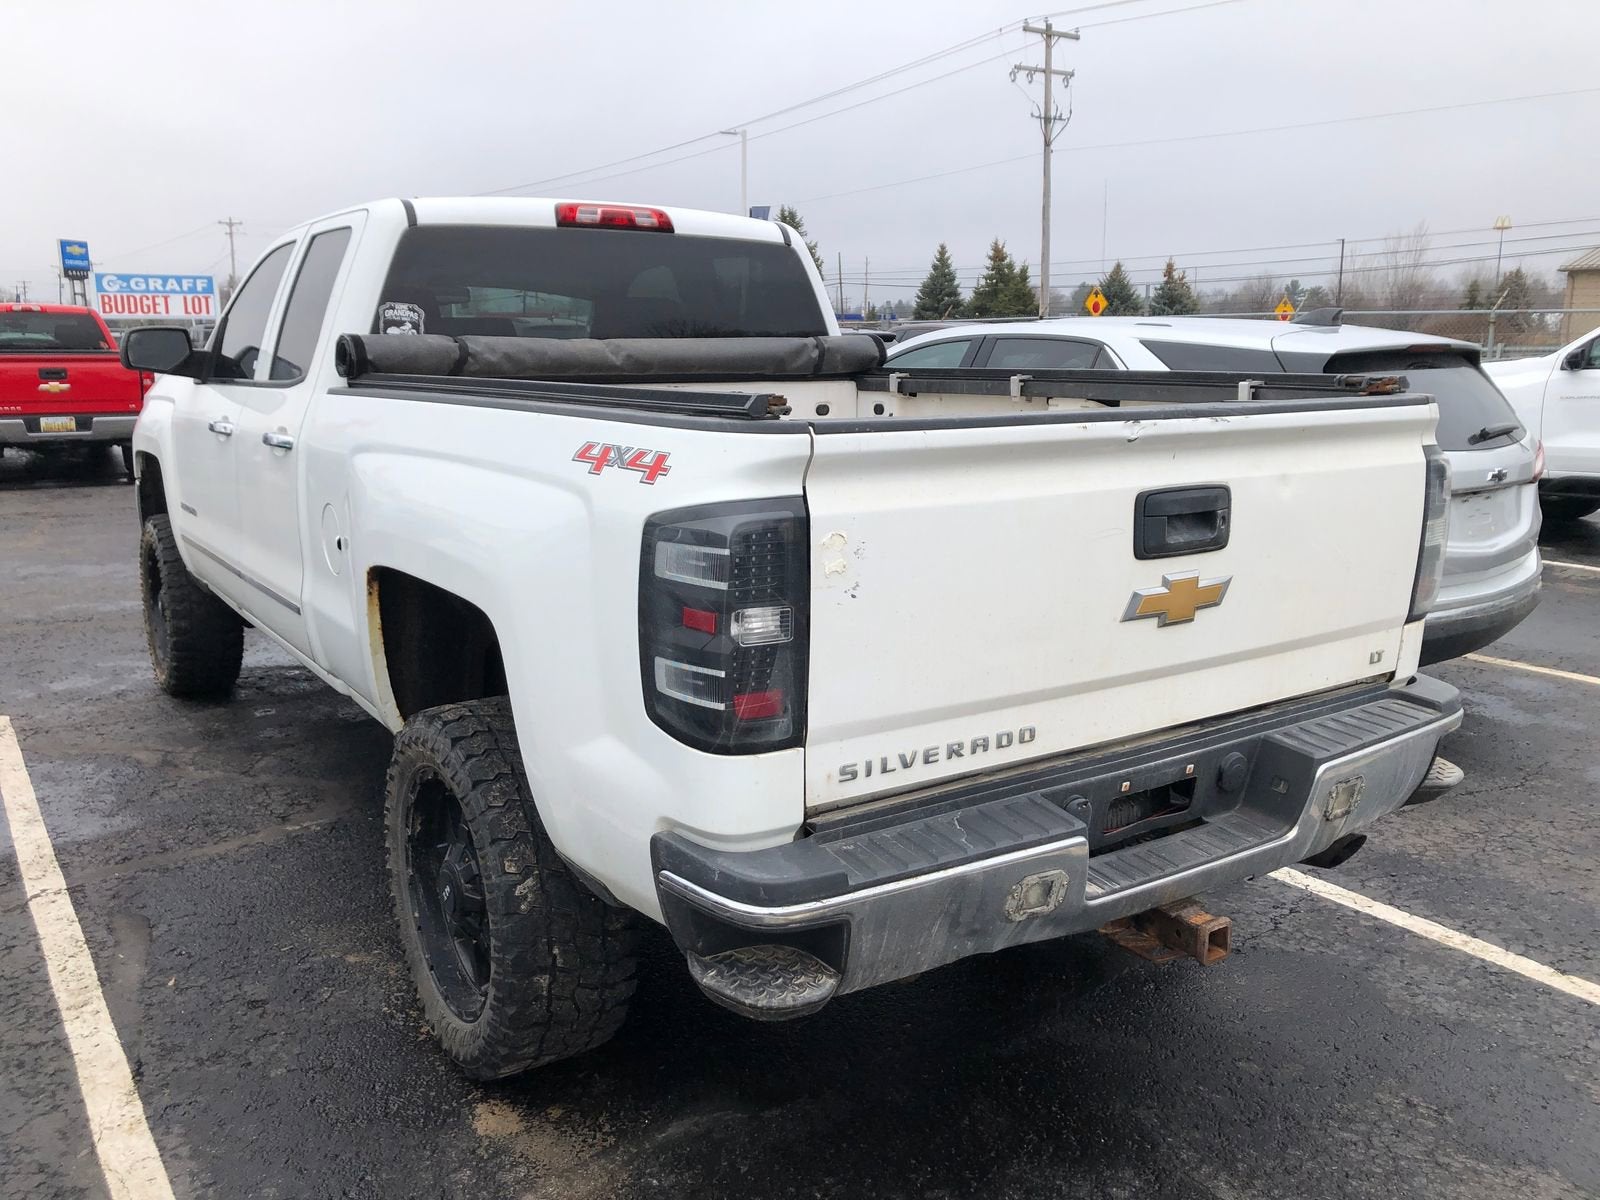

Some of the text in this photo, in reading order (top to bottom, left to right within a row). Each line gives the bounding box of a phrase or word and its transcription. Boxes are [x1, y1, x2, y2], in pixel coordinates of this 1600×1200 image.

[130, 277, 208, 292] GRAFF
[101, 294, 211, 315] BUDGET LOT
[1369, 649, 1385, 665] LT
[838, 725, 1036, 783] SILVERADO
